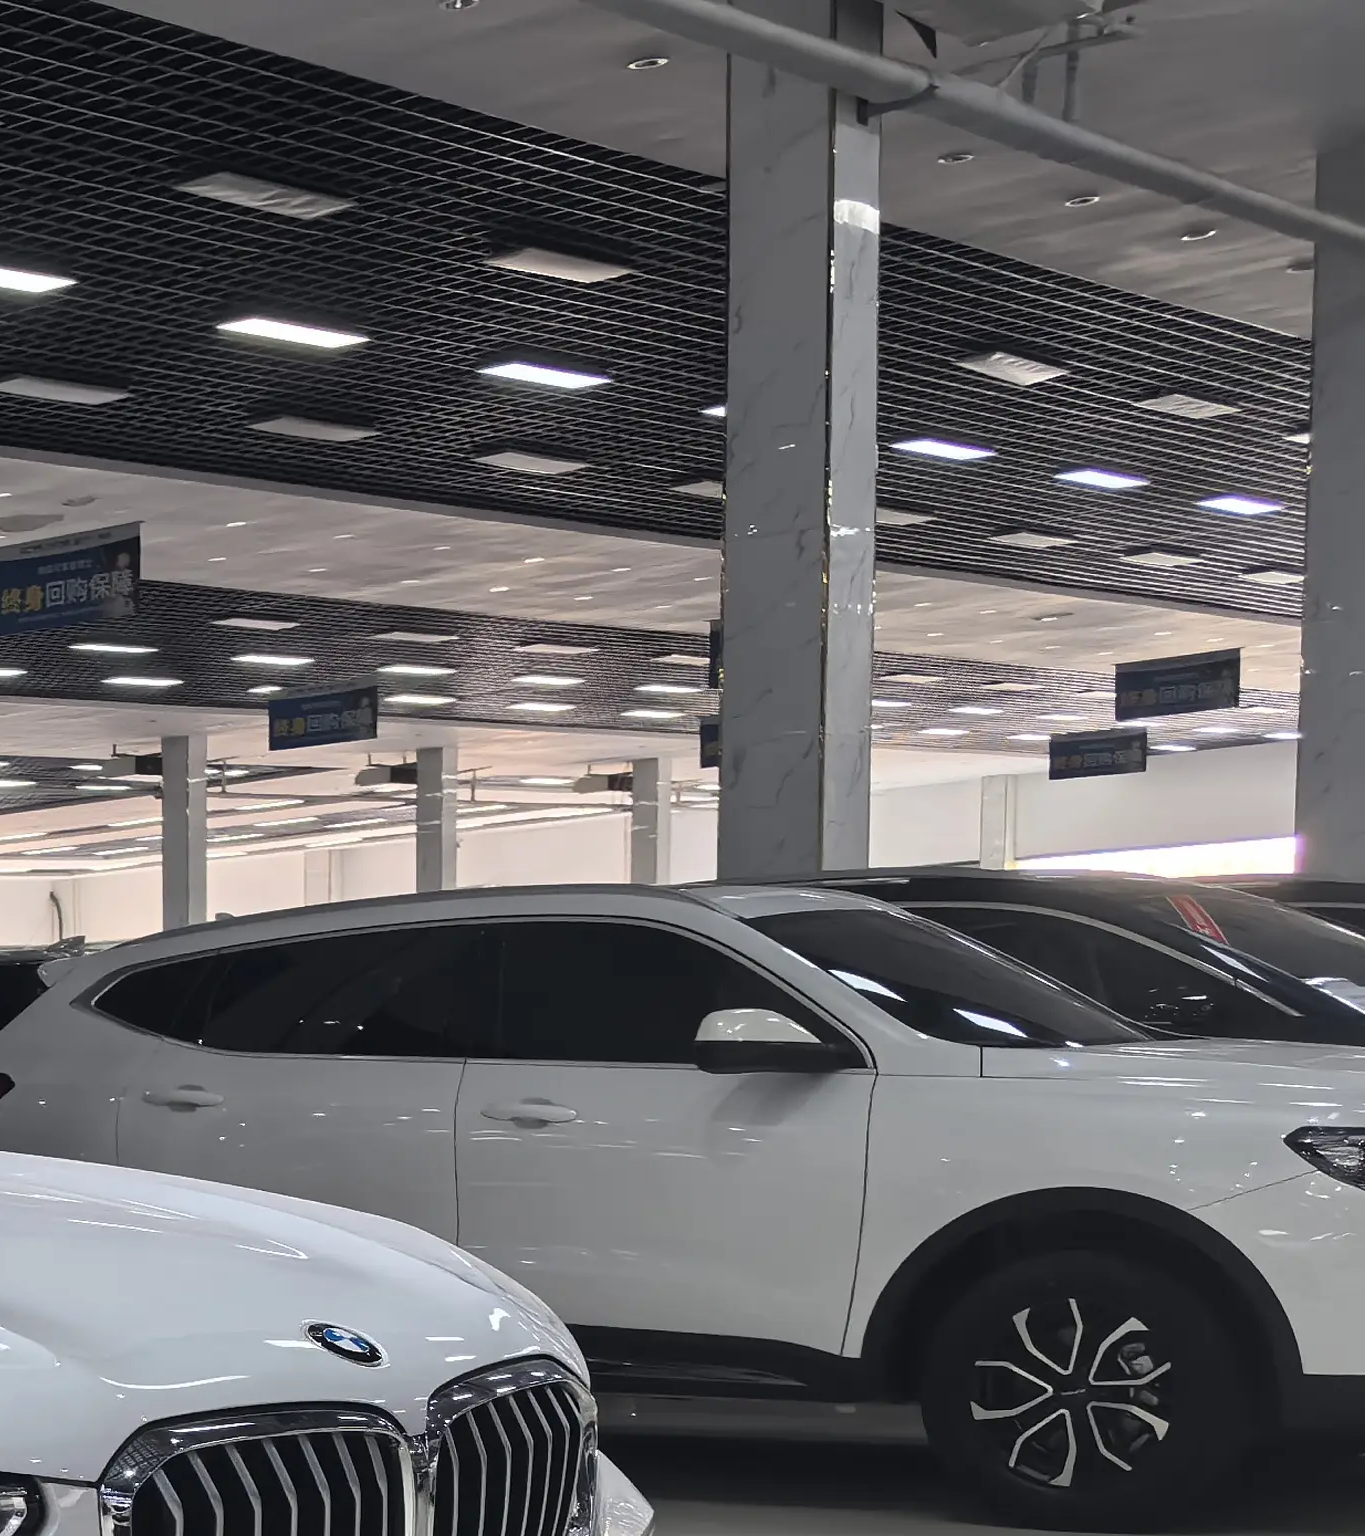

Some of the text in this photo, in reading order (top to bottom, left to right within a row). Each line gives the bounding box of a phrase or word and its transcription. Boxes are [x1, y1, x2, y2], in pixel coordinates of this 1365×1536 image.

[0, 568, 134, 616] 终身回购保障
